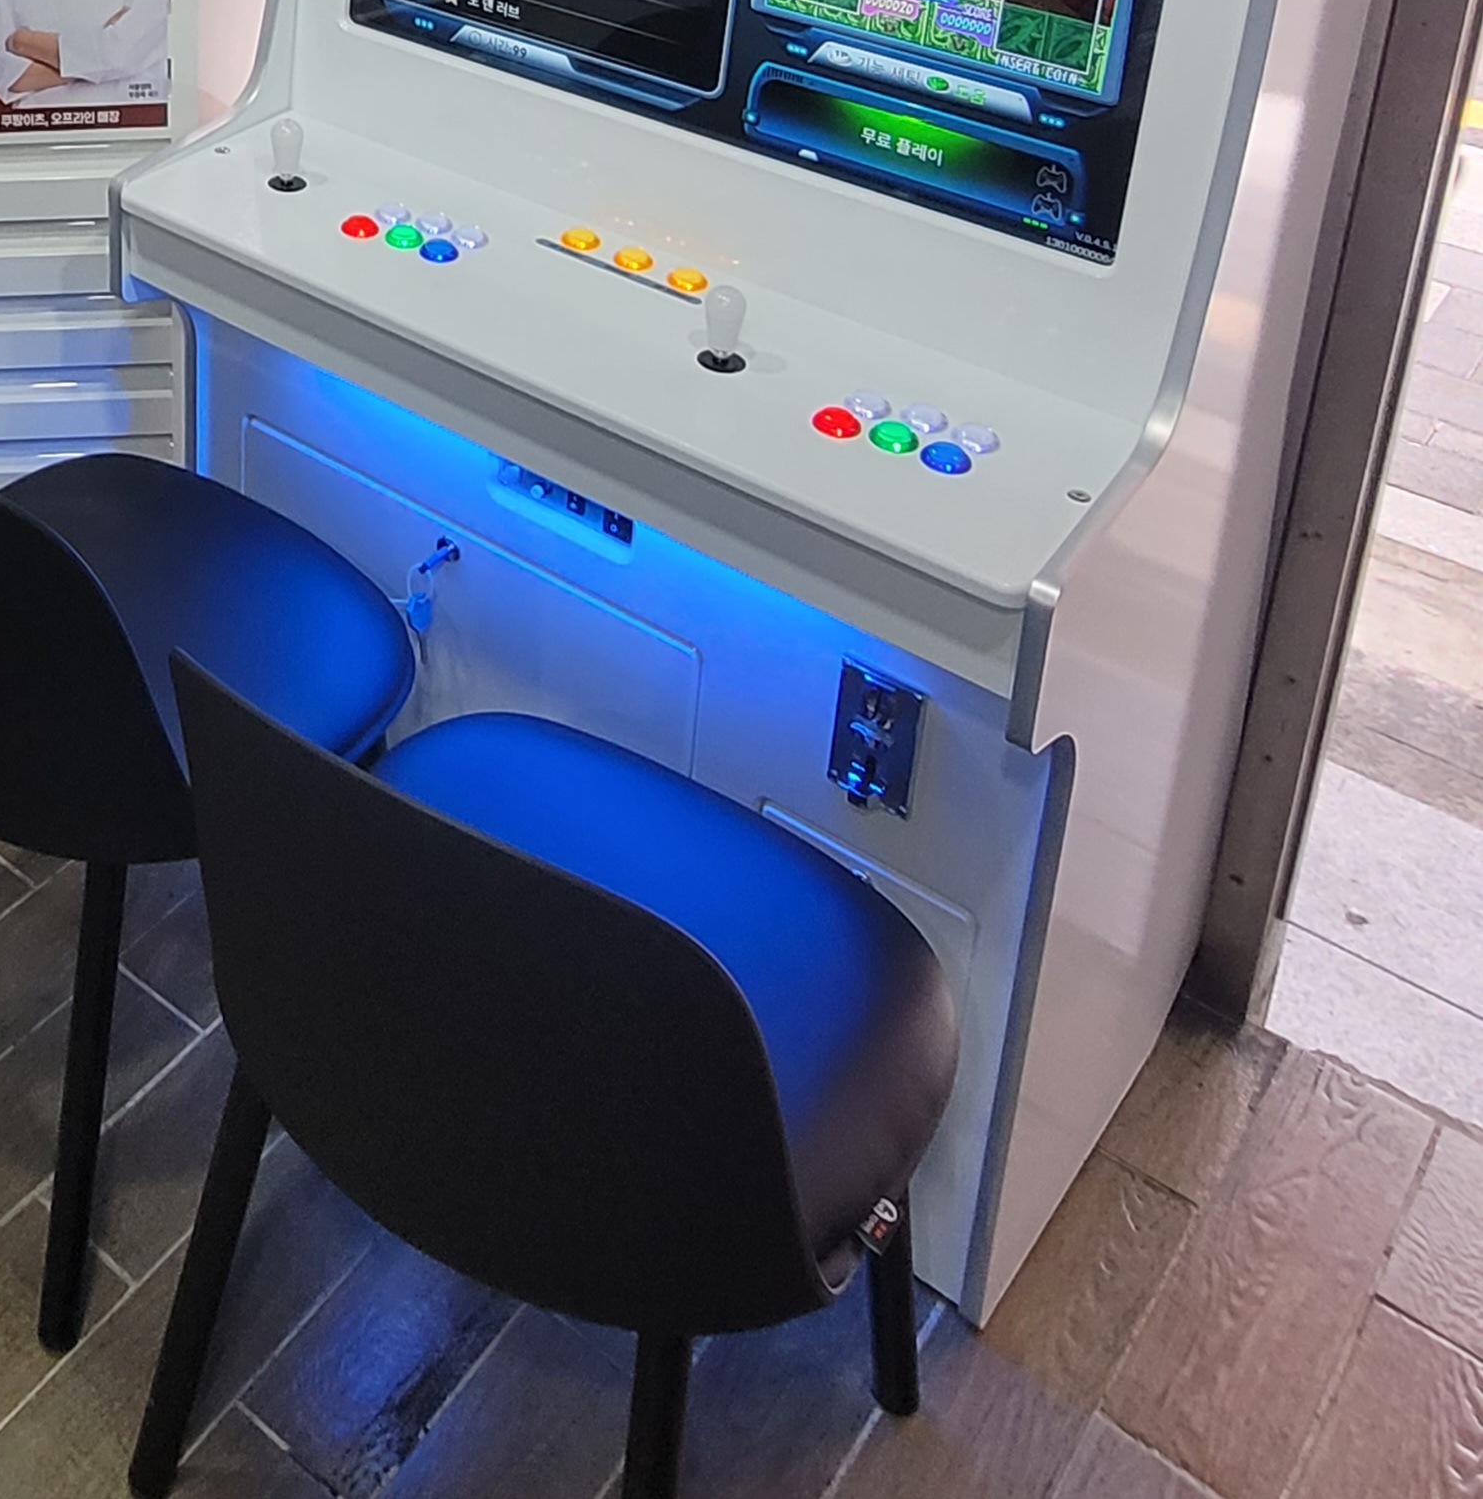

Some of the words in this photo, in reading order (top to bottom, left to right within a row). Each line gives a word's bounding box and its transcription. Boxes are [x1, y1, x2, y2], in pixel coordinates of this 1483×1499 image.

[961, 3, 994, 21] SCORE
[50, 111, 96, 125] 오프라인
[859, 126, 892, 150] 무료
[895, 136, 944, 168] 플레이
